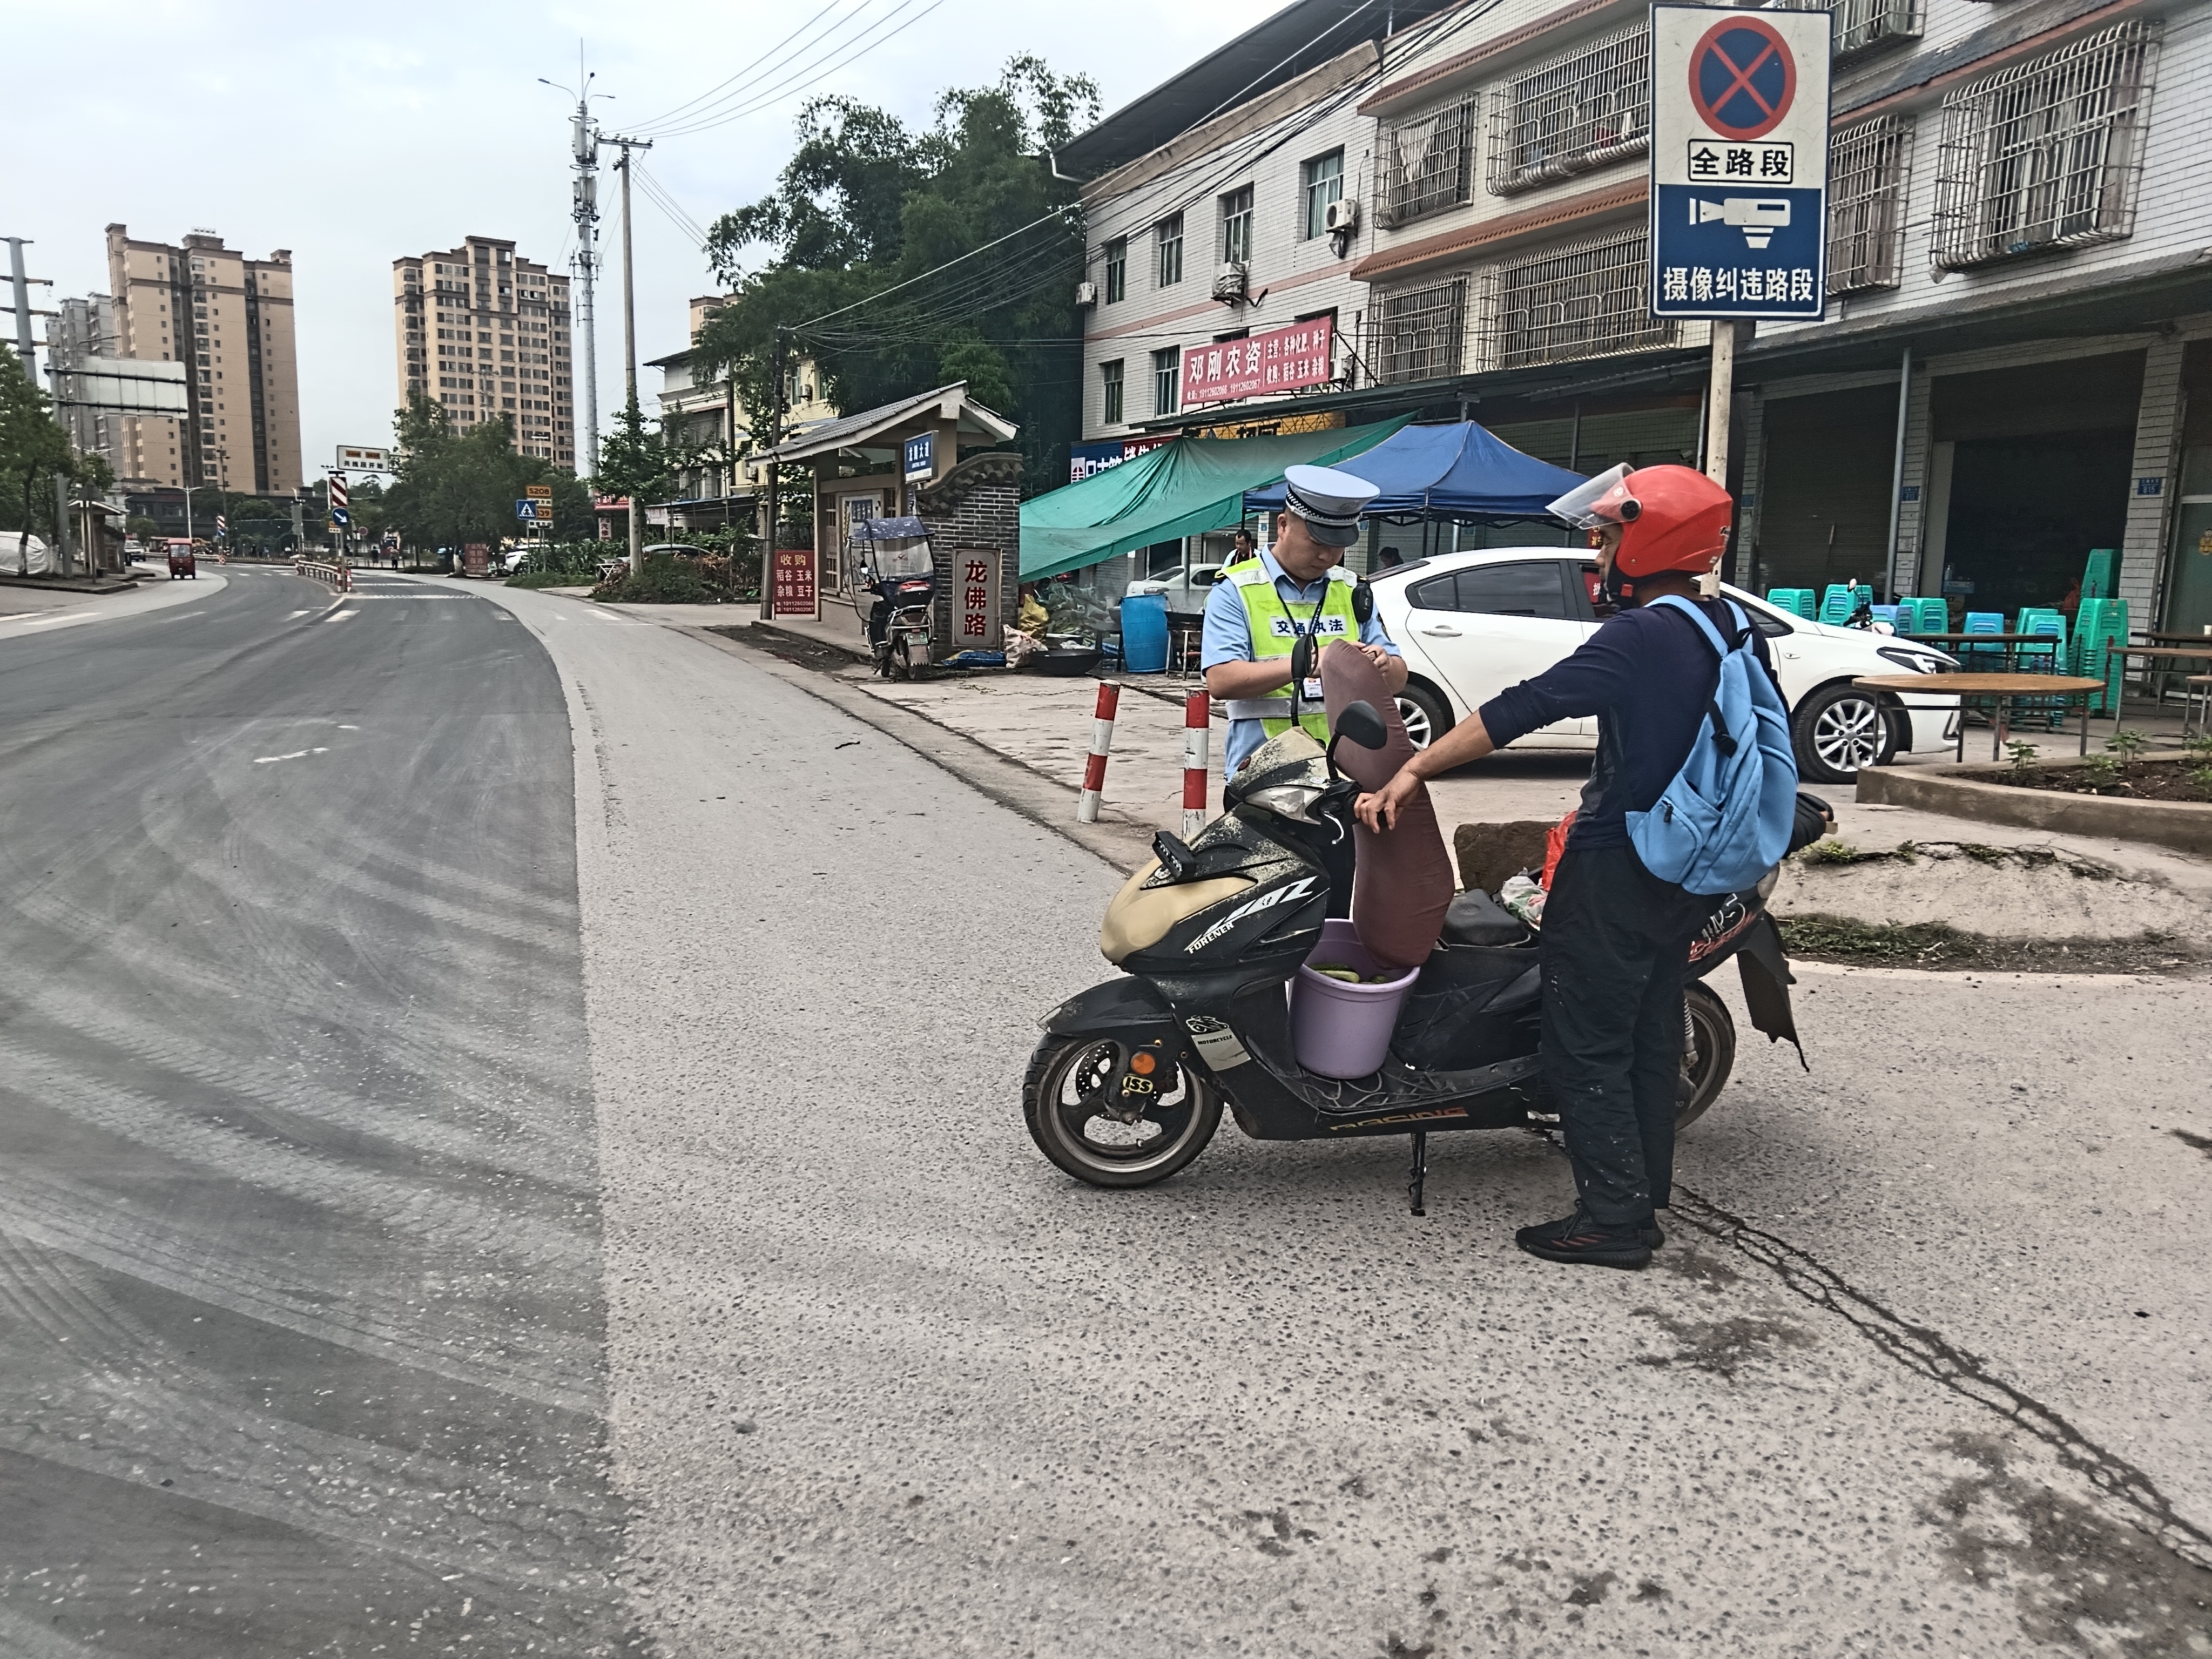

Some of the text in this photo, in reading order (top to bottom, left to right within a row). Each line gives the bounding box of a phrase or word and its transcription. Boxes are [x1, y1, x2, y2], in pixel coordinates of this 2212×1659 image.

[1691, 147, 1789, 177] 全路段
[1663, 266, 1813, 302] 摄像纠违路段
[1189, 340, 1262, 385] 邓刚农资
[1297, 358, 1310, 379] 玉米
[1199, 384, 1228, 399] 19112602066
[1230, 378, 1260, 394] 19112602067
[780, 554, 806, 566] 收购
[796, 569, 812, 582] 玉米
[777, 585, 813, 597] 杂粮 豆子
[964, 559, 988, 637] 龙佛路
[1197, 1034, 1233, 1045] MOTORCYCLE
[1125, 1076, 1151, 1092] ISS
